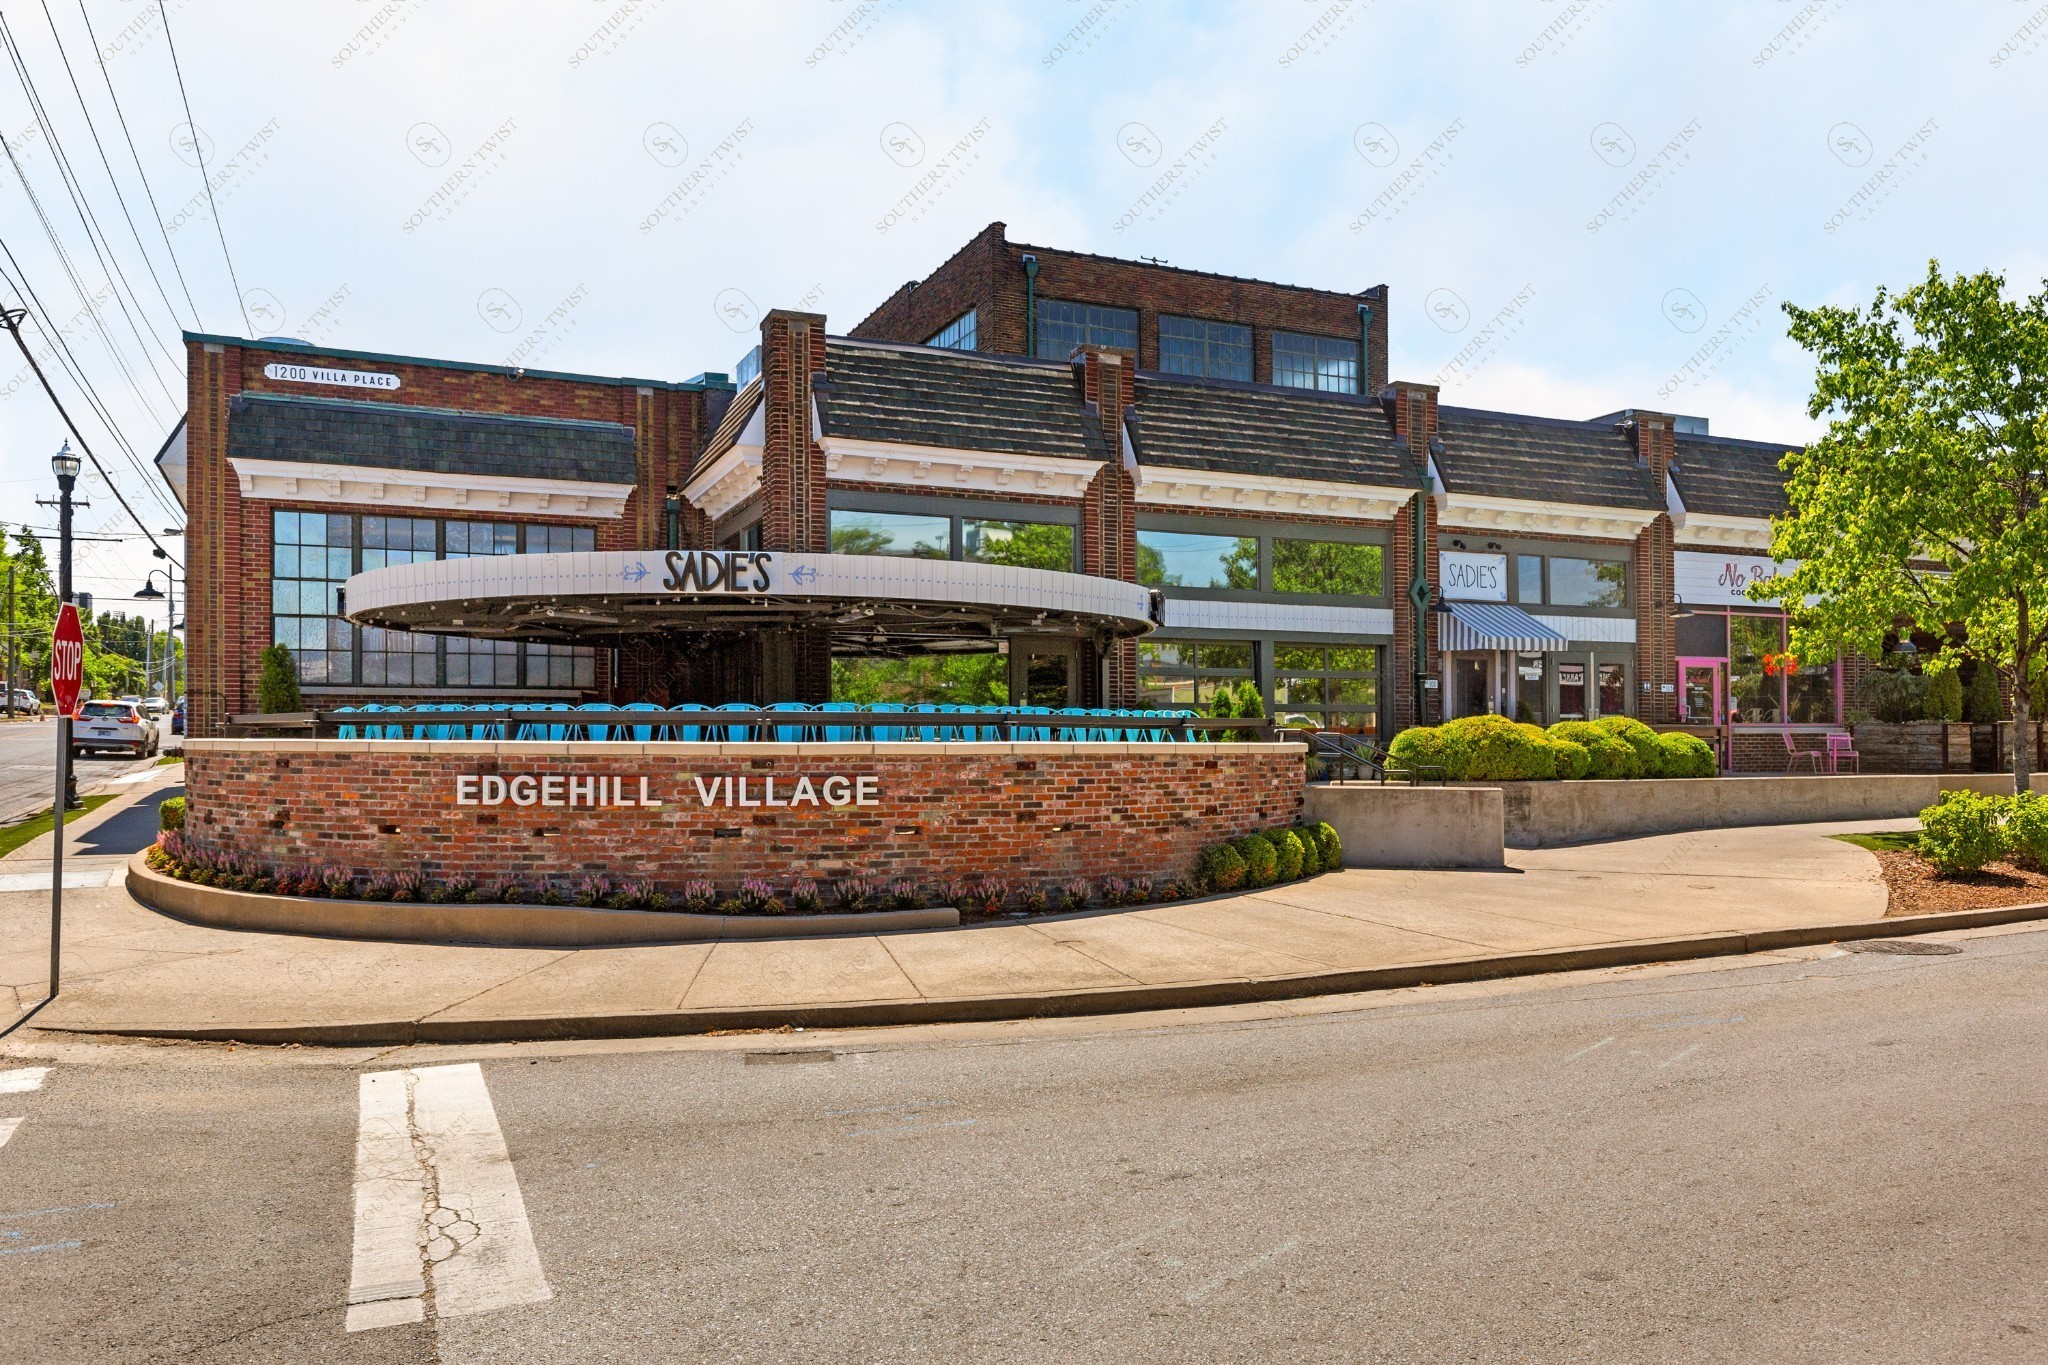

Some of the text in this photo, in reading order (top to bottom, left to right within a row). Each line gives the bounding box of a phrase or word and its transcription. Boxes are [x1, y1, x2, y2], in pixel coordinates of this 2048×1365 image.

[274, 365, 391, 387] 1200 VILLA PLACE
[663, 551, 772, 592] SADIE'S
[1448, 563, 1497, 589] SADIE'S
[1718, 563, 1746, 587] No
[54, 639, 81, 681] STOP
[456, 774, 880, 807] EDGEHILL VILLAGE
